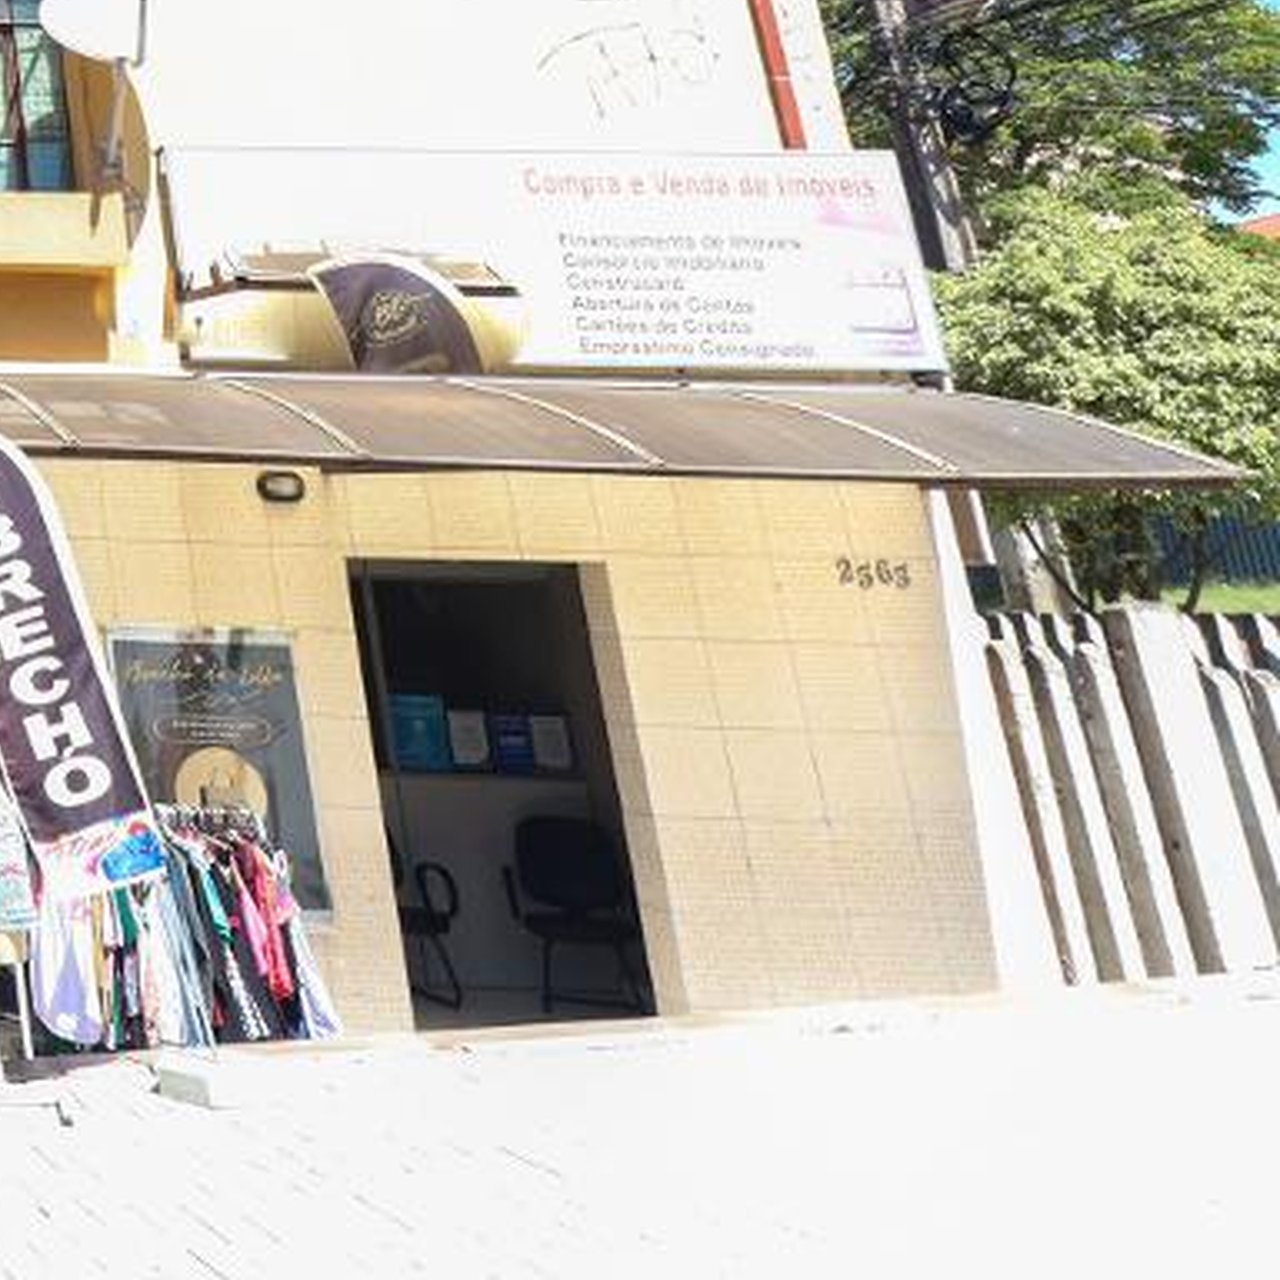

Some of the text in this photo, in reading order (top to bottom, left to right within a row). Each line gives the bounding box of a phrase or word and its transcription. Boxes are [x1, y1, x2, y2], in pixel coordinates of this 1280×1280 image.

[523, 167, 622, 201] Compra
[628, 175, 645, 196] e
[655, 168, 730, 198] Venda
[739, 172, 769, 198] de
